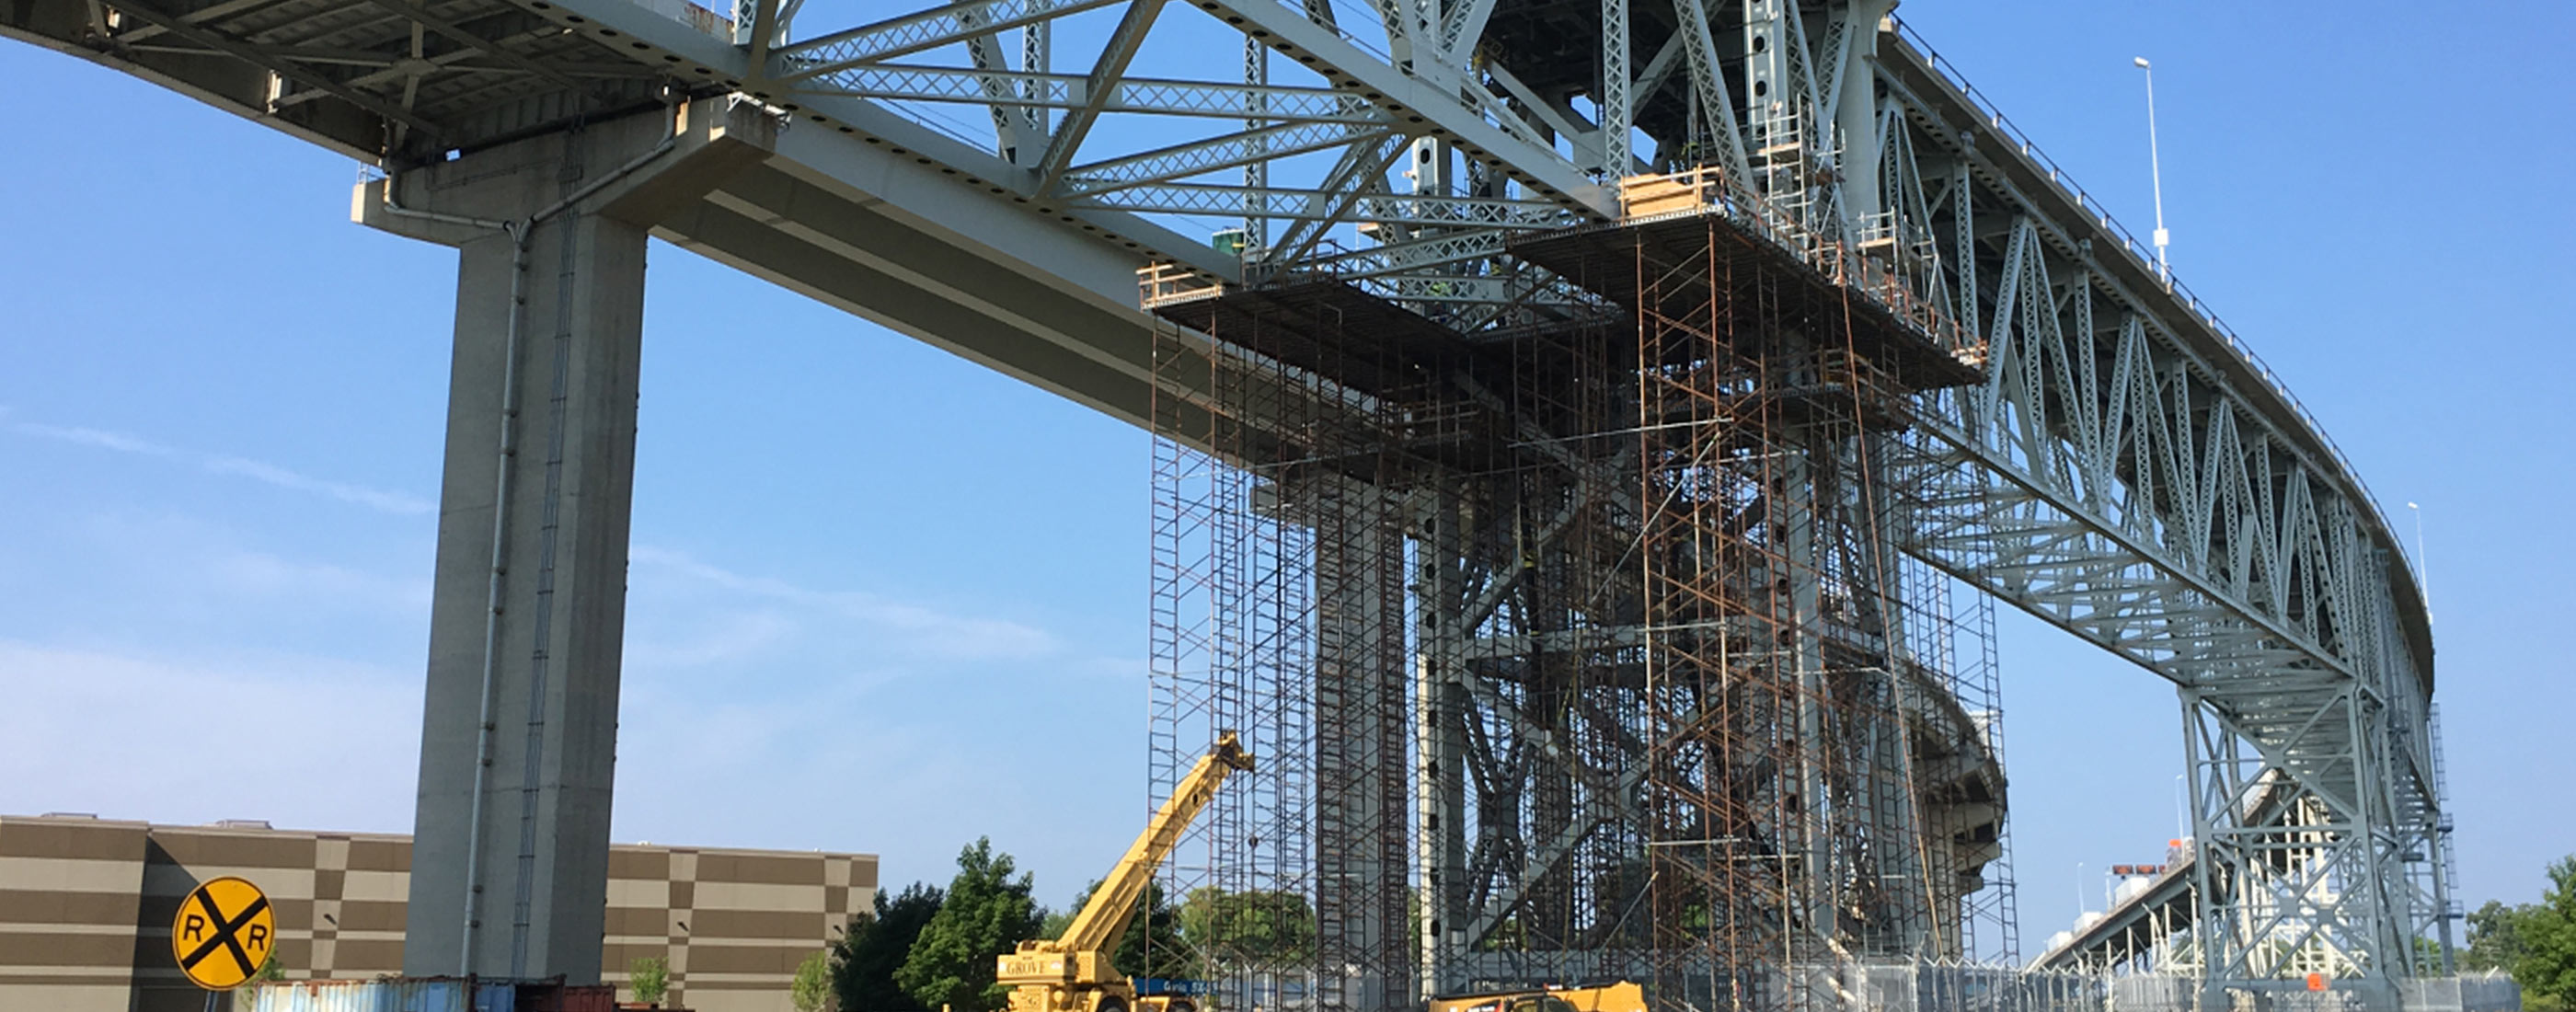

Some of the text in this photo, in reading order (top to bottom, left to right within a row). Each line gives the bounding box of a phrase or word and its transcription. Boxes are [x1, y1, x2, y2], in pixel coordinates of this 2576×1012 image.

[183, 914, 268, 951] R R
[1006, 960, 1045, 974] GROVE
